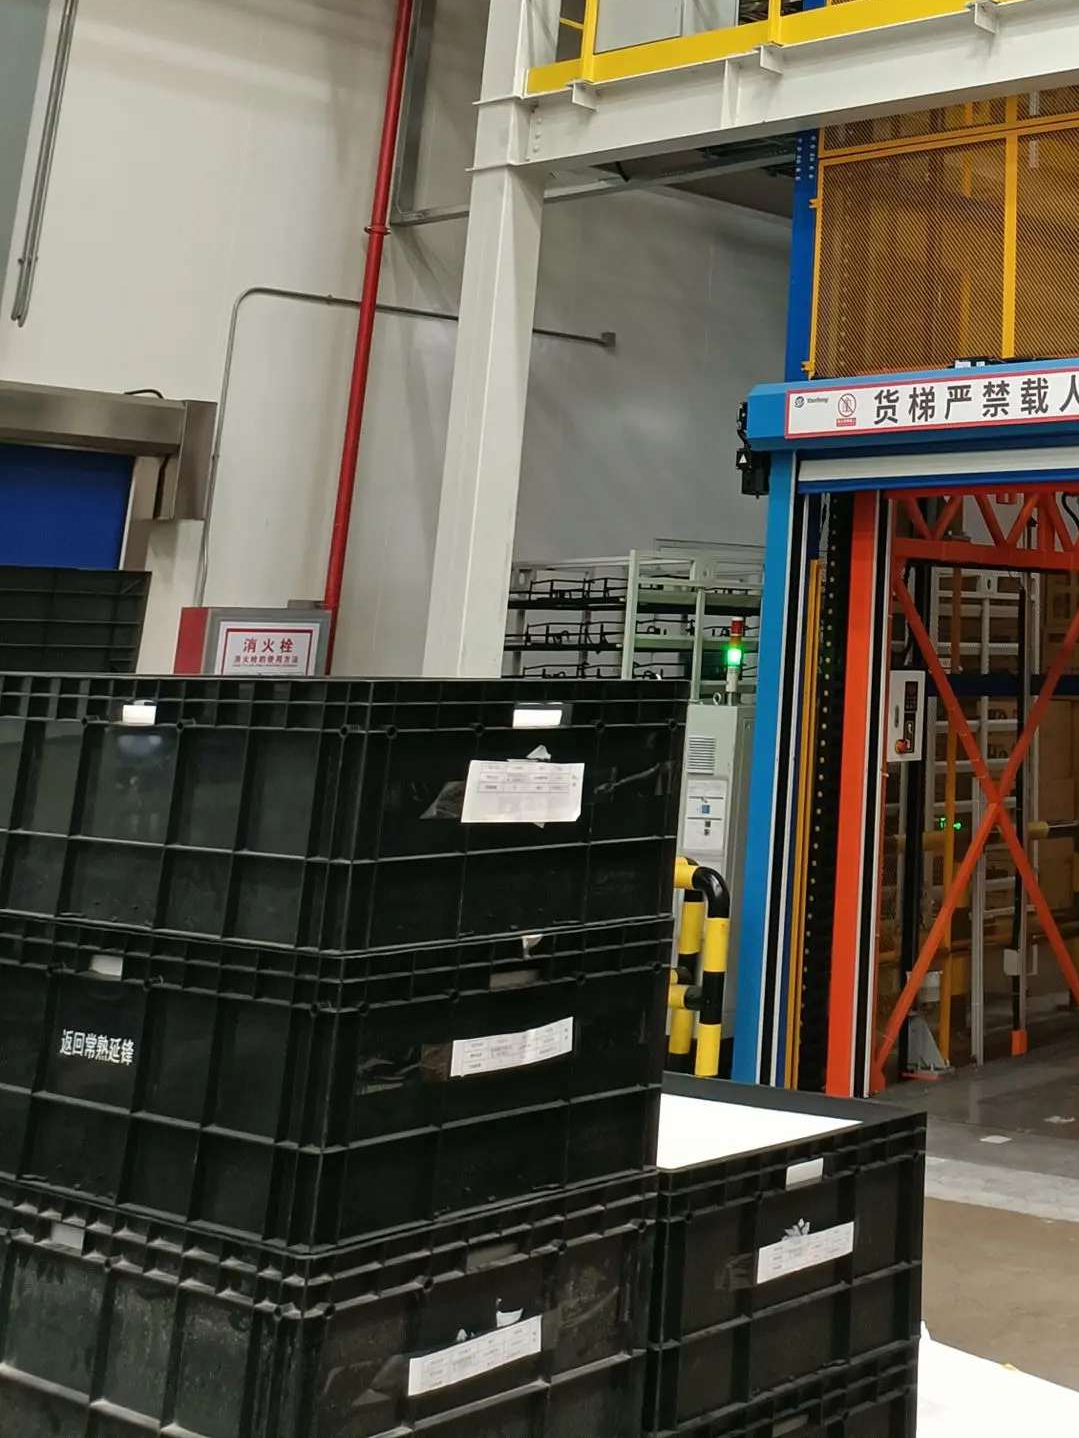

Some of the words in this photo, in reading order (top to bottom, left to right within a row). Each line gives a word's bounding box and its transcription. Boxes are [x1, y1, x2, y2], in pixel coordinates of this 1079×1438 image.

[243, 637, 293, 653] 消火栓
[60, 1029, 134, 1066] 返回常熟延锋
